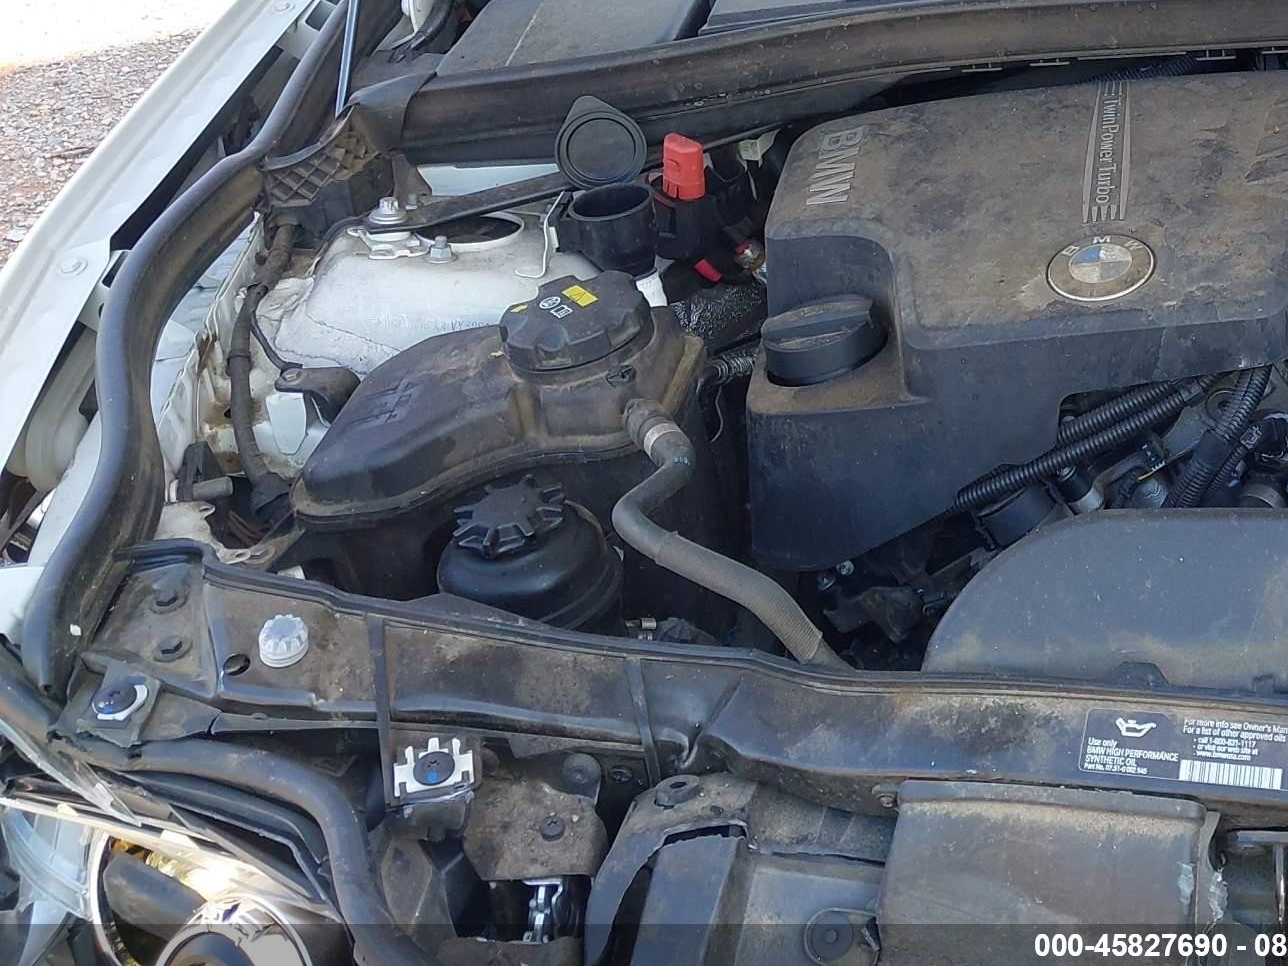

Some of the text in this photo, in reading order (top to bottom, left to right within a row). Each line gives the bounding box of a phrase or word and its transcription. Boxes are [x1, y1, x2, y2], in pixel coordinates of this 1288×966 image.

[1099, 97, 1121, 163] TwinPower
[806, 126, 865, 205] BMW
[1183, 725, 1194, 734] For
[1201, 726, 1212, 735] list
[1212, 727, 1220, 736] of
[1221, 729, 1239, 738] other
[1240, 731, 1273, 741] approved
[1274, 734, 1286, 742] oils
[1215, 720, 1229, 728] info
[1243, 723, 1271, 732] Owner's
[1102, 740, 1118, 749] only
[1085, 755, 1137, 767] SYNTHETIC OIL
[1087, 746, 1179, 761] BMW HIGH PERFORMANCE
